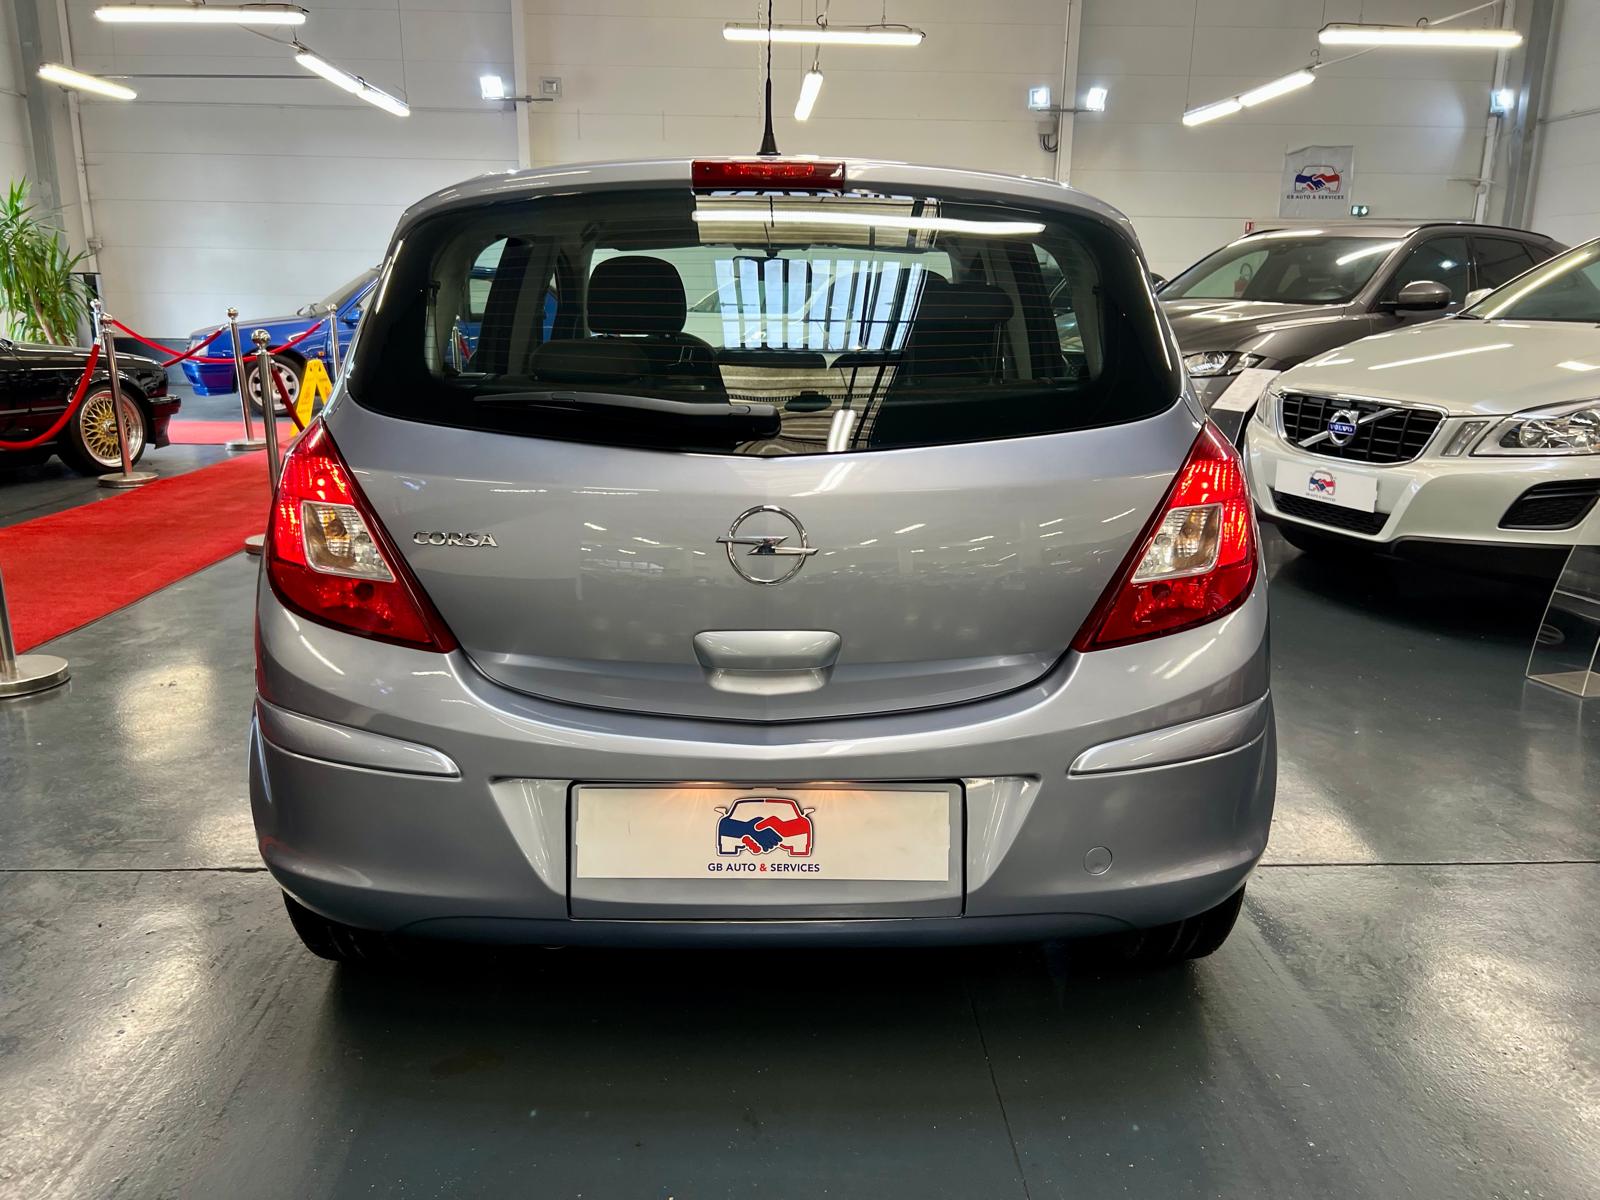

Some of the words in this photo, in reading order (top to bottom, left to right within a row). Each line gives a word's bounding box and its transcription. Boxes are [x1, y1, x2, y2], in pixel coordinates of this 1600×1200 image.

[1330, 424, 1353, 432] VOLVO
[413, 531, 498, 547] CORSA
[707, 863, 723, 872] GB
[726, 863, 757, 872] AUTO
[759, 863, 767, 872] &
[770, 863, 820, 872] SERVICES
